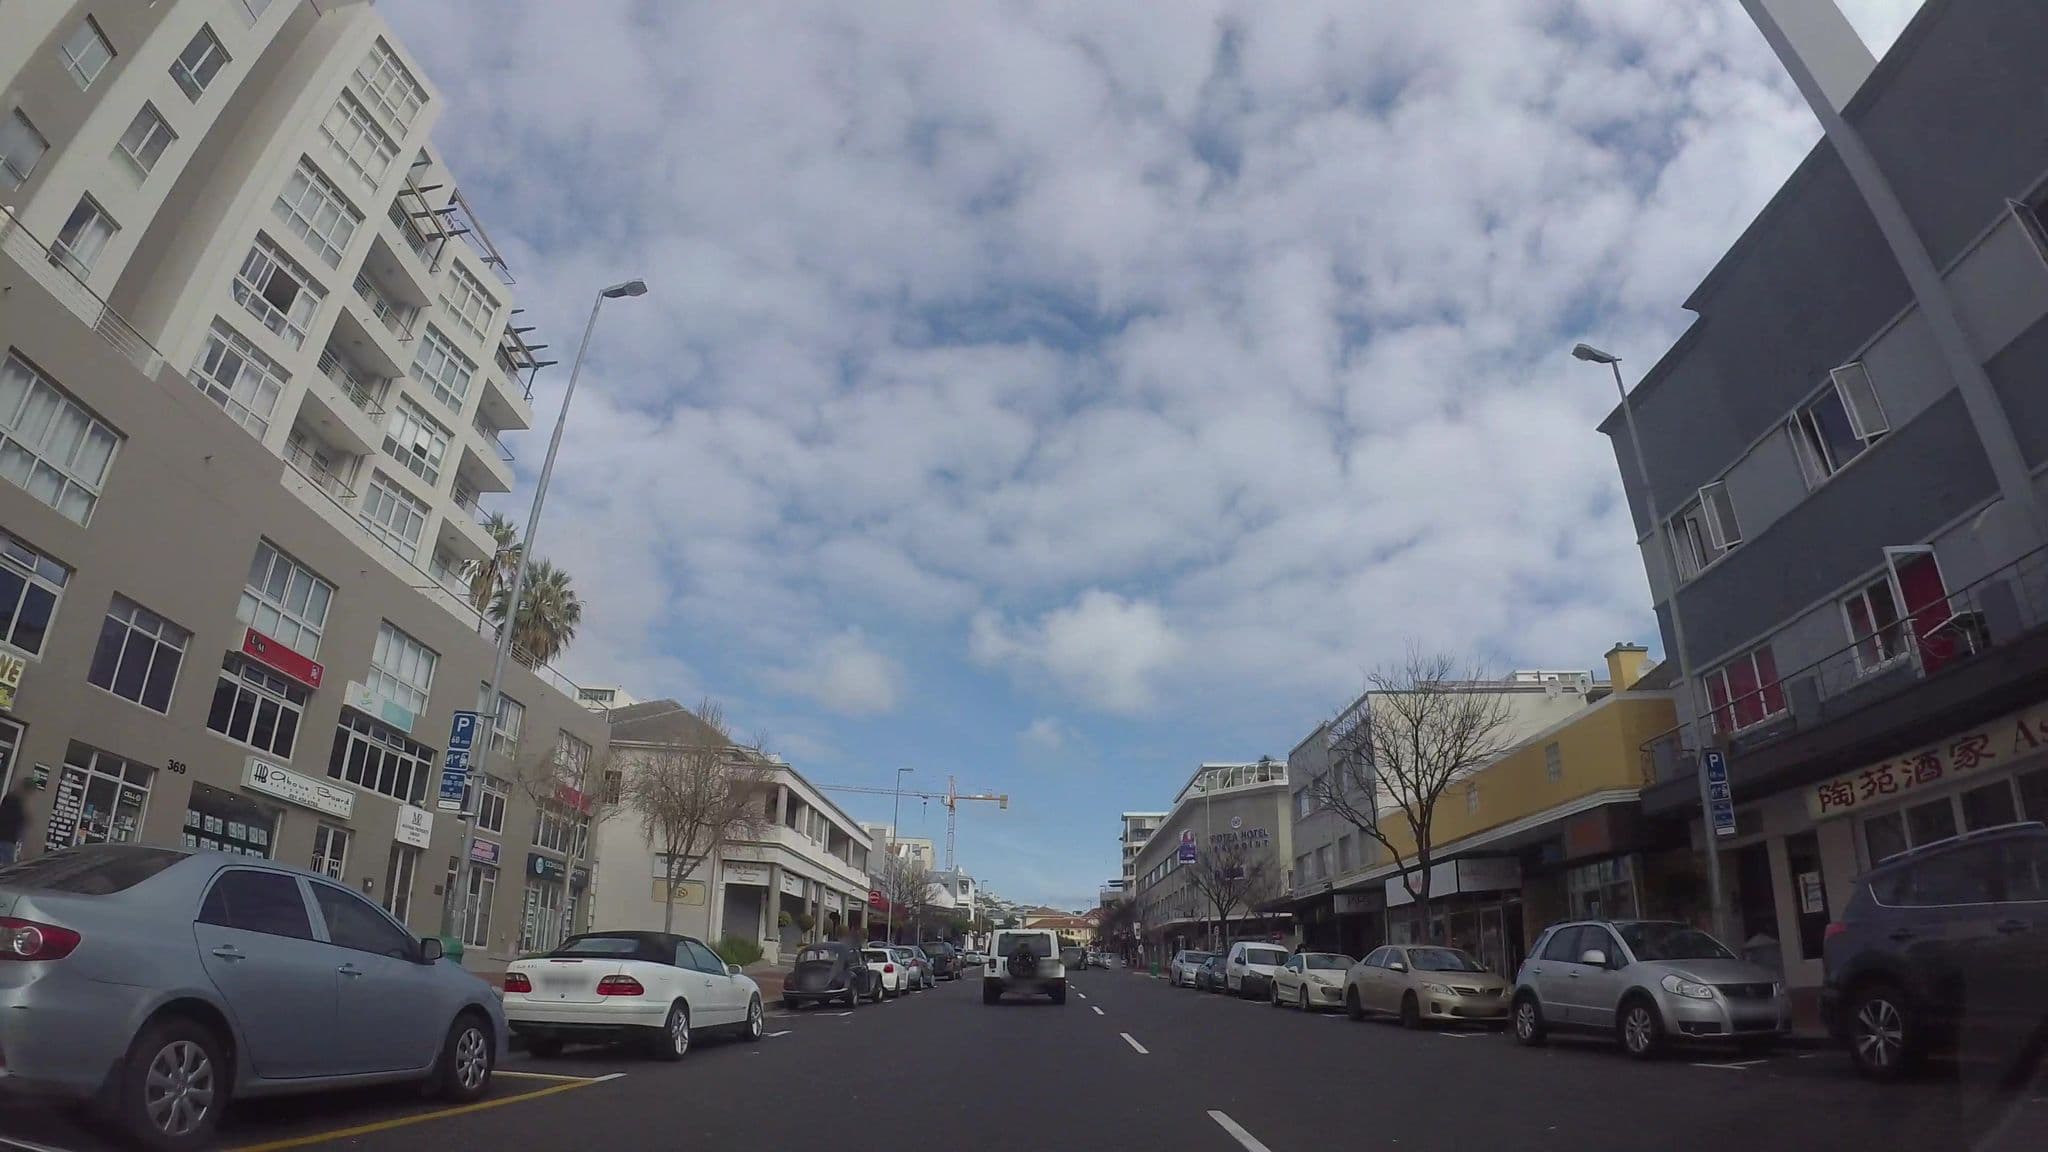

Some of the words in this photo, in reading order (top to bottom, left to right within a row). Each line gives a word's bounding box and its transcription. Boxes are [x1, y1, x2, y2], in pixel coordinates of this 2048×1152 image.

[457, 717, 470, 732] P
[167, 759, 186, 775] 369
[1709, 753, 1719, 768] P
[1818, 734, 1996, 813] 陶苑酒家
[315, 786, 350, 805] Board
[1241, 827, 1269, 840] HOTEL
